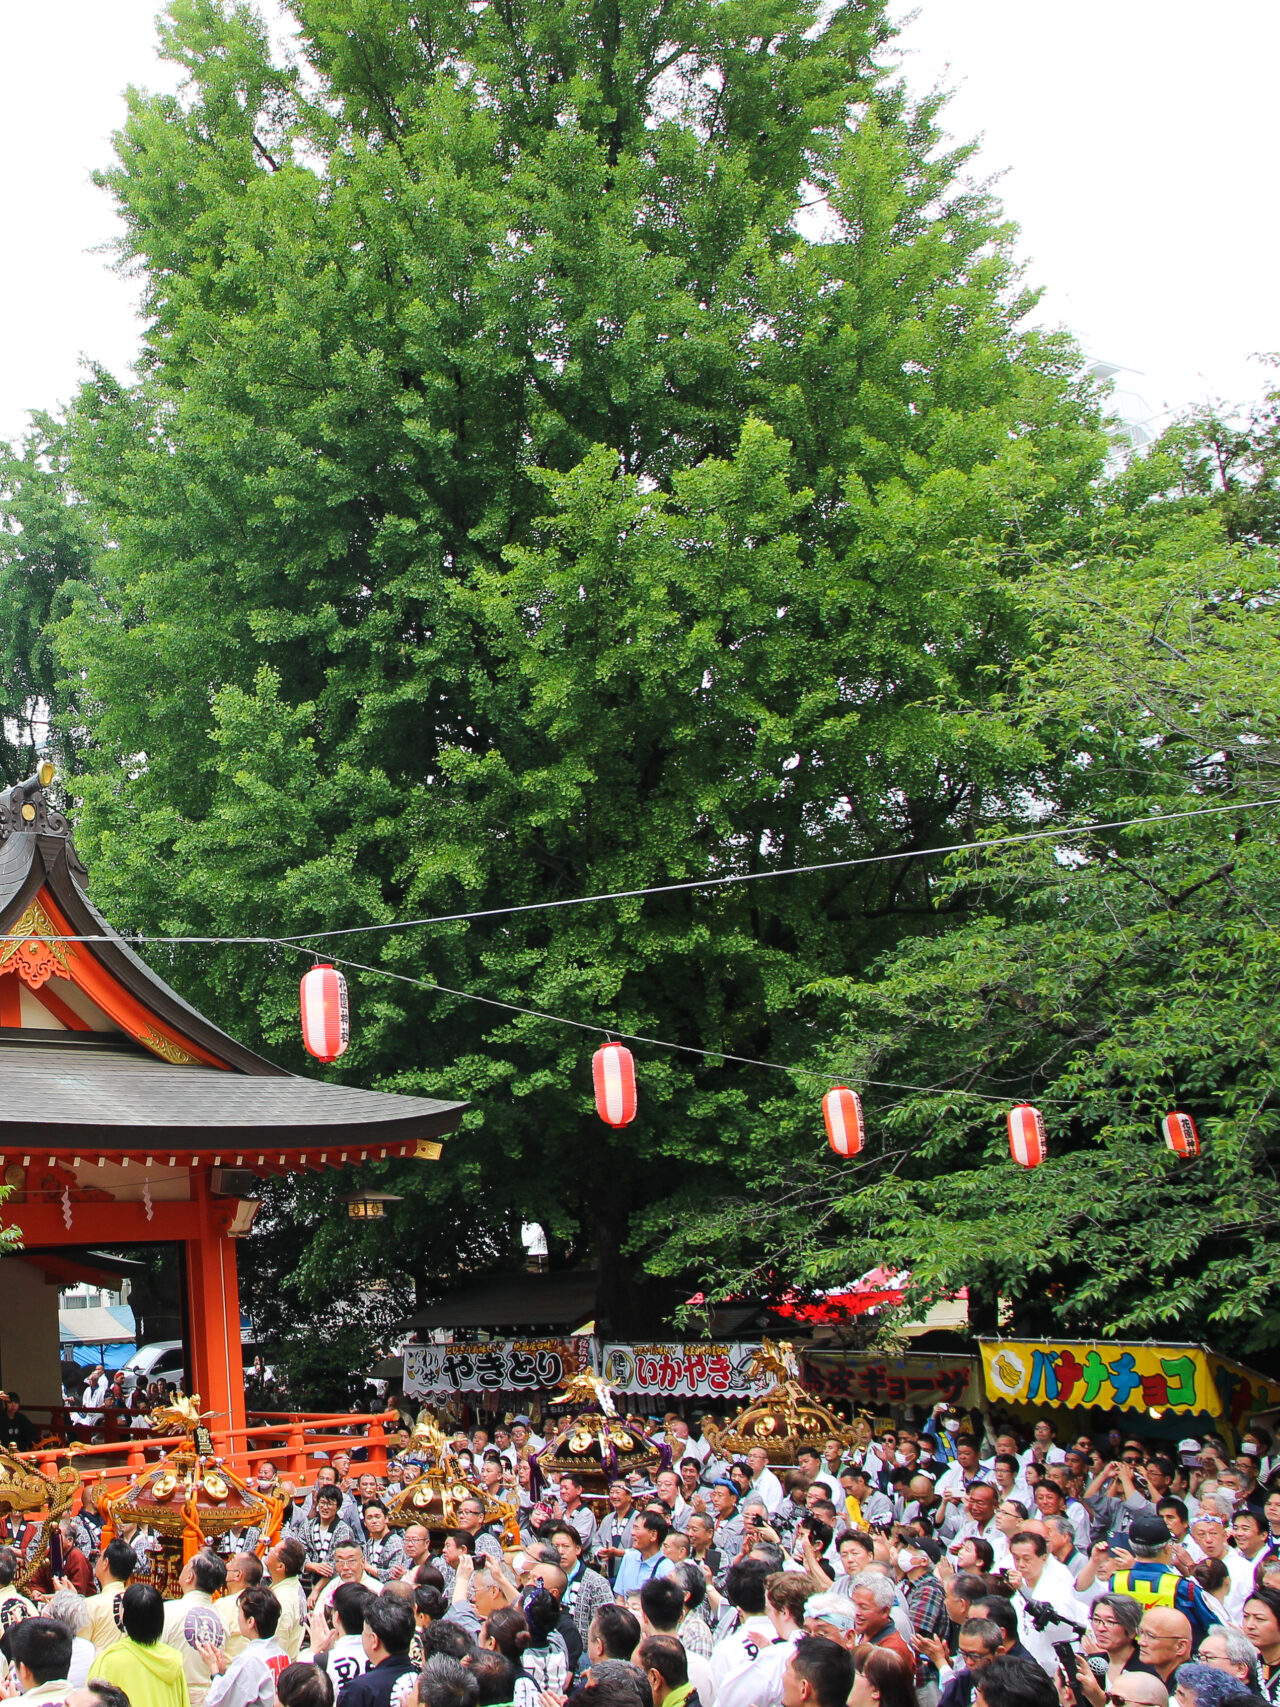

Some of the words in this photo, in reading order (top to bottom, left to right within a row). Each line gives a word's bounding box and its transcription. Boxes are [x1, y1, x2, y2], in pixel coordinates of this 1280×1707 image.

[442, 1352, 563, 1389] やきとり
[635, 1355, 733, 1392] いかやき
[1026, 1349, 1197, 1406] バナナチョコ
